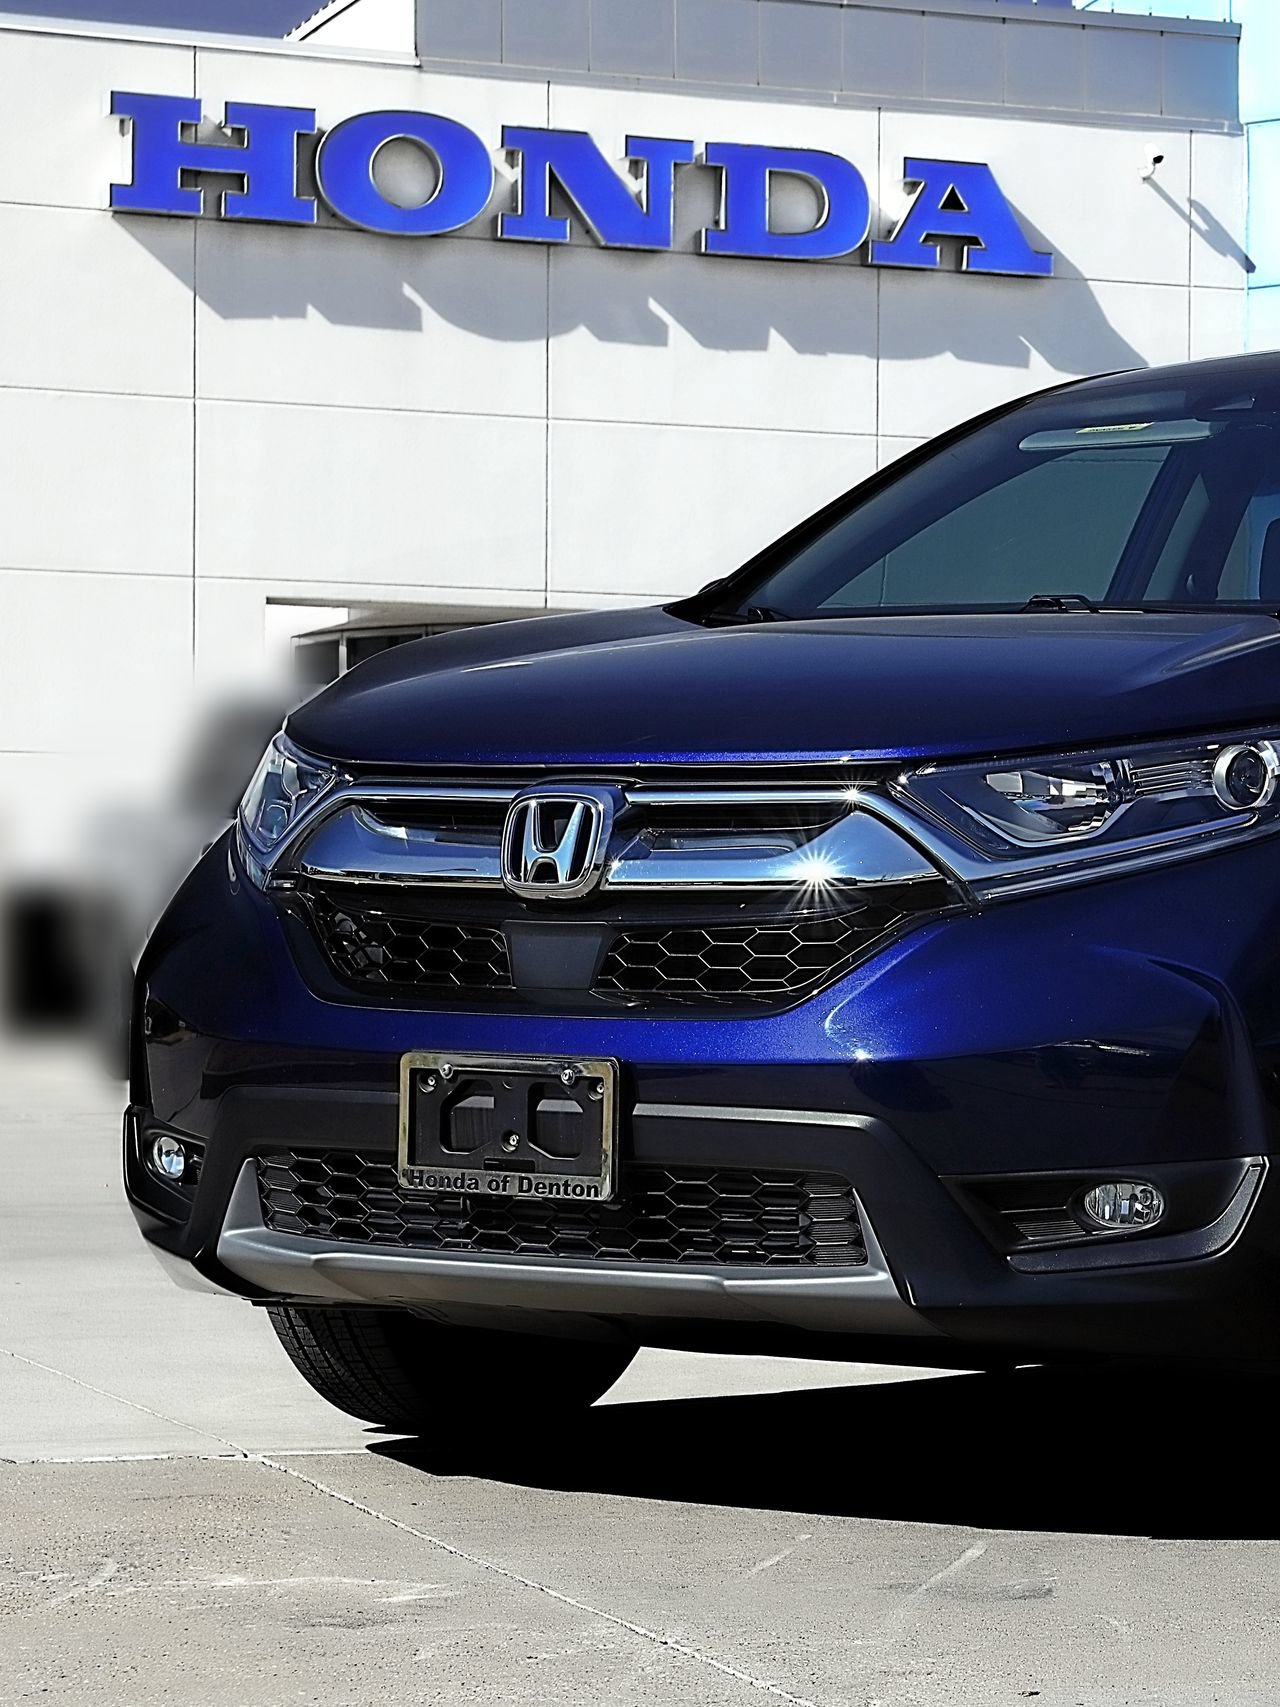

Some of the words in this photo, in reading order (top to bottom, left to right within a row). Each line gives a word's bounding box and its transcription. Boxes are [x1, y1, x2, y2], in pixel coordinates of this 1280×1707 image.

[110, 91, 1053, 276] HONDA
[411, 1169, 479, 1191] Honda
[487, 1175, 510, 1193] of
[518, 1175, 600, 1198] Denton
